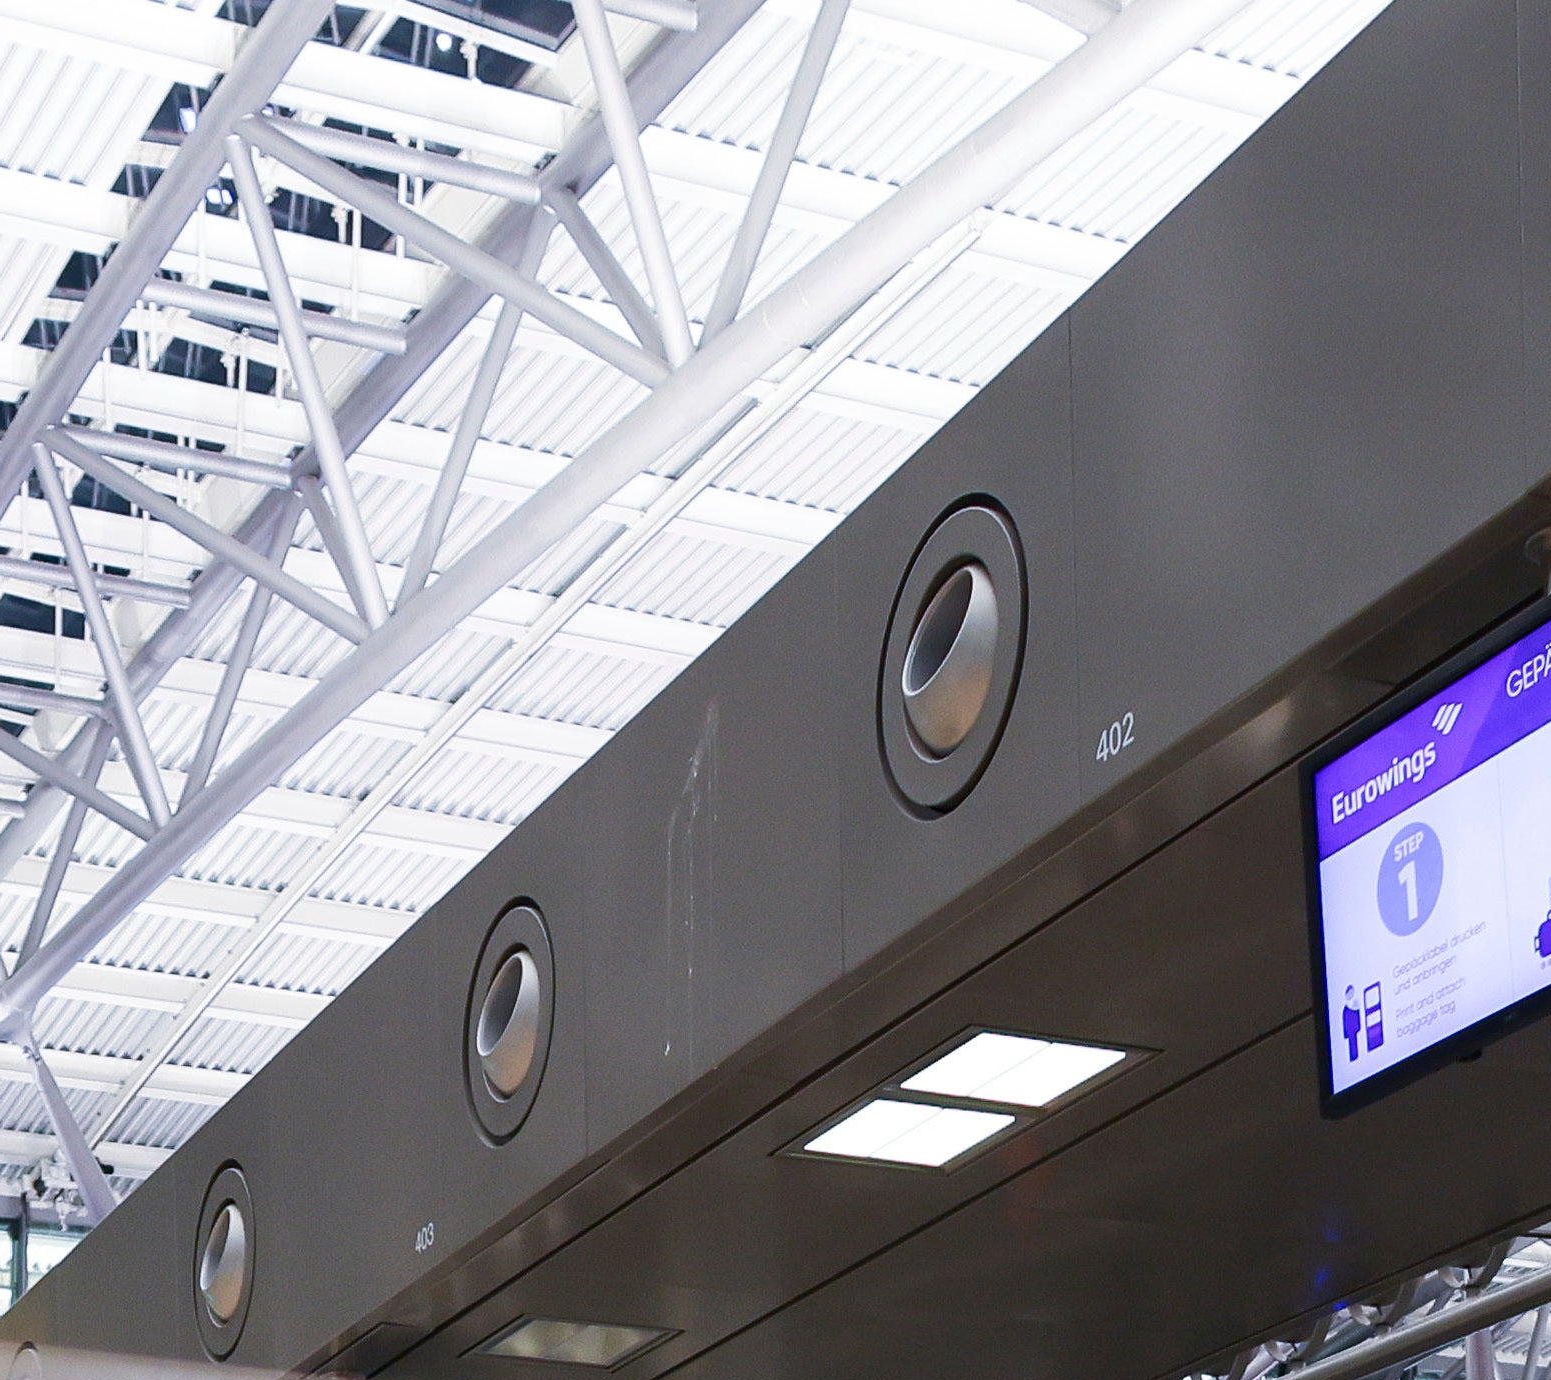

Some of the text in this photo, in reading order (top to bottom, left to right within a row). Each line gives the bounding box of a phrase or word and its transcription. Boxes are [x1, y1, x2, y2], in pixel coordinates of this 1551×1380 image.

[1096, 712, 1134, 762] 402
[1332, 741, 1436, 824] Eurowings
[1393, 831, 1424, 862] STEP
[1397, 862, 1418, 922] 1
[1451, 919, 1487, 951] drucken
[1393, 954, 1457, 998] und anbringen
[1395, 975, 1467, 1022] Print and attach
[1397, 998, 1456, 1040] baggage tag
[415, 1222, 434, 1254] 403
